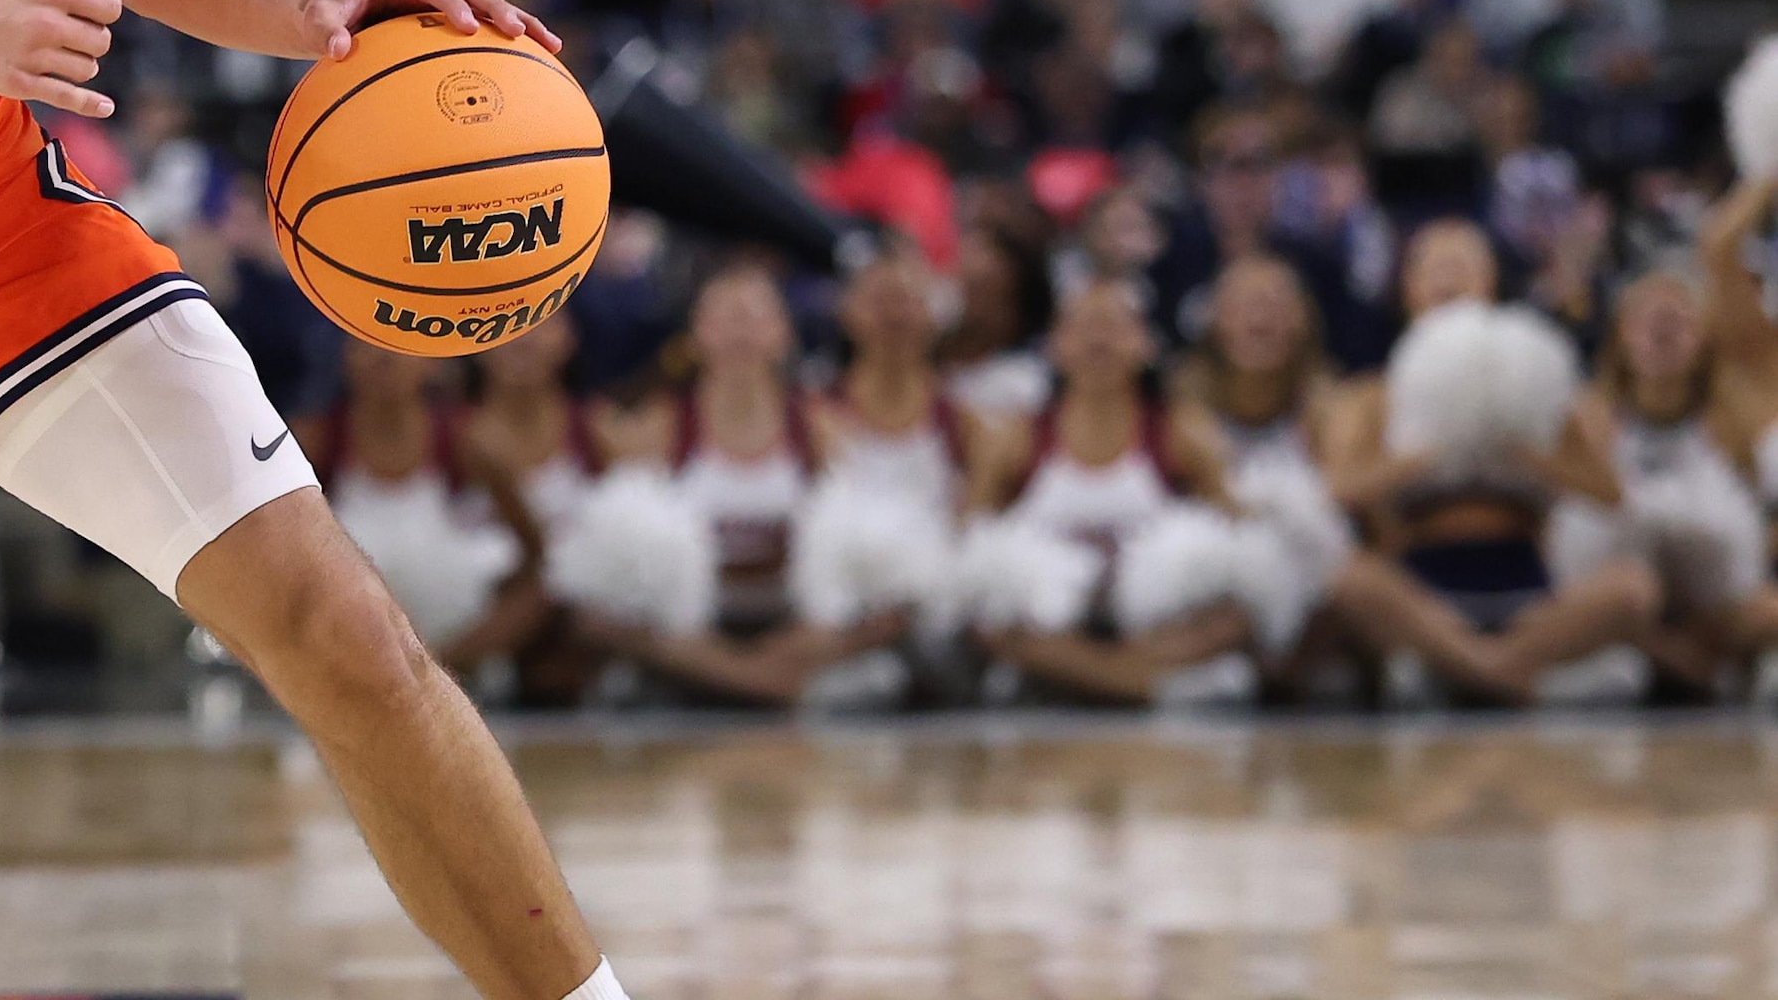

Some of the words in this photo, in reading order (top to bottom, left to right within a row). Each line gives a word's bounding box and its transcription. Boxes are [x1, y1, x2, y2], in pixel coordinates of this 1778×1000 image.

[506, 184, 564, 205] OFFICIAL
[409, 206, 453, 214] BALL
[457, 200, 502, 213] GAME
[407, 196, 565, 265] NCAA
[373, 272, 581, 345] Wilson
[458, 306, 491, 316] NXT
[495, 298, 525, 312] EVO
